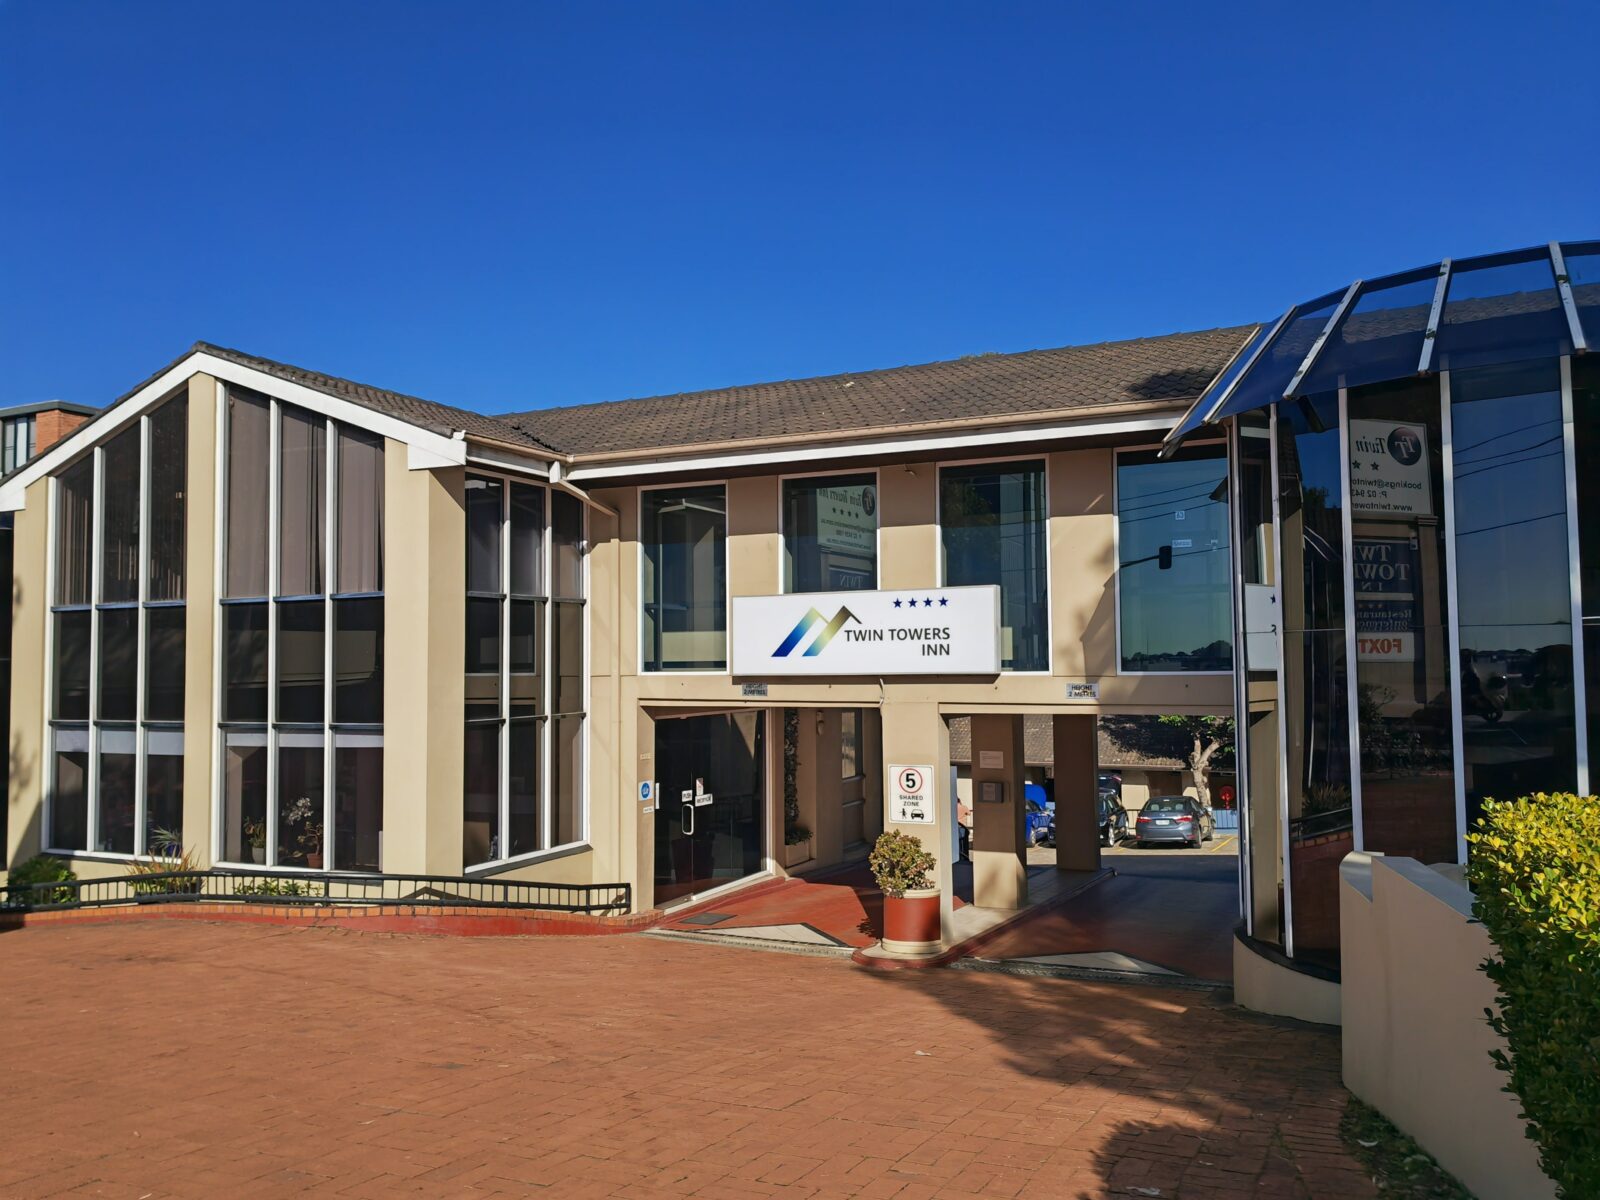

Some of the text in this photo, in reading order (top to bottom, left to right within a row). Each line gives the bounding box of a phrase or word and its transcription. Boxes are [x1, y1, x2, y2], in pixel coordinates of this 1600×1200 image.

[844, 627, 951, 642] TWIN TOWERS
[921, 643, 951, 656] INN
[905, 772, 916, 788] 5
